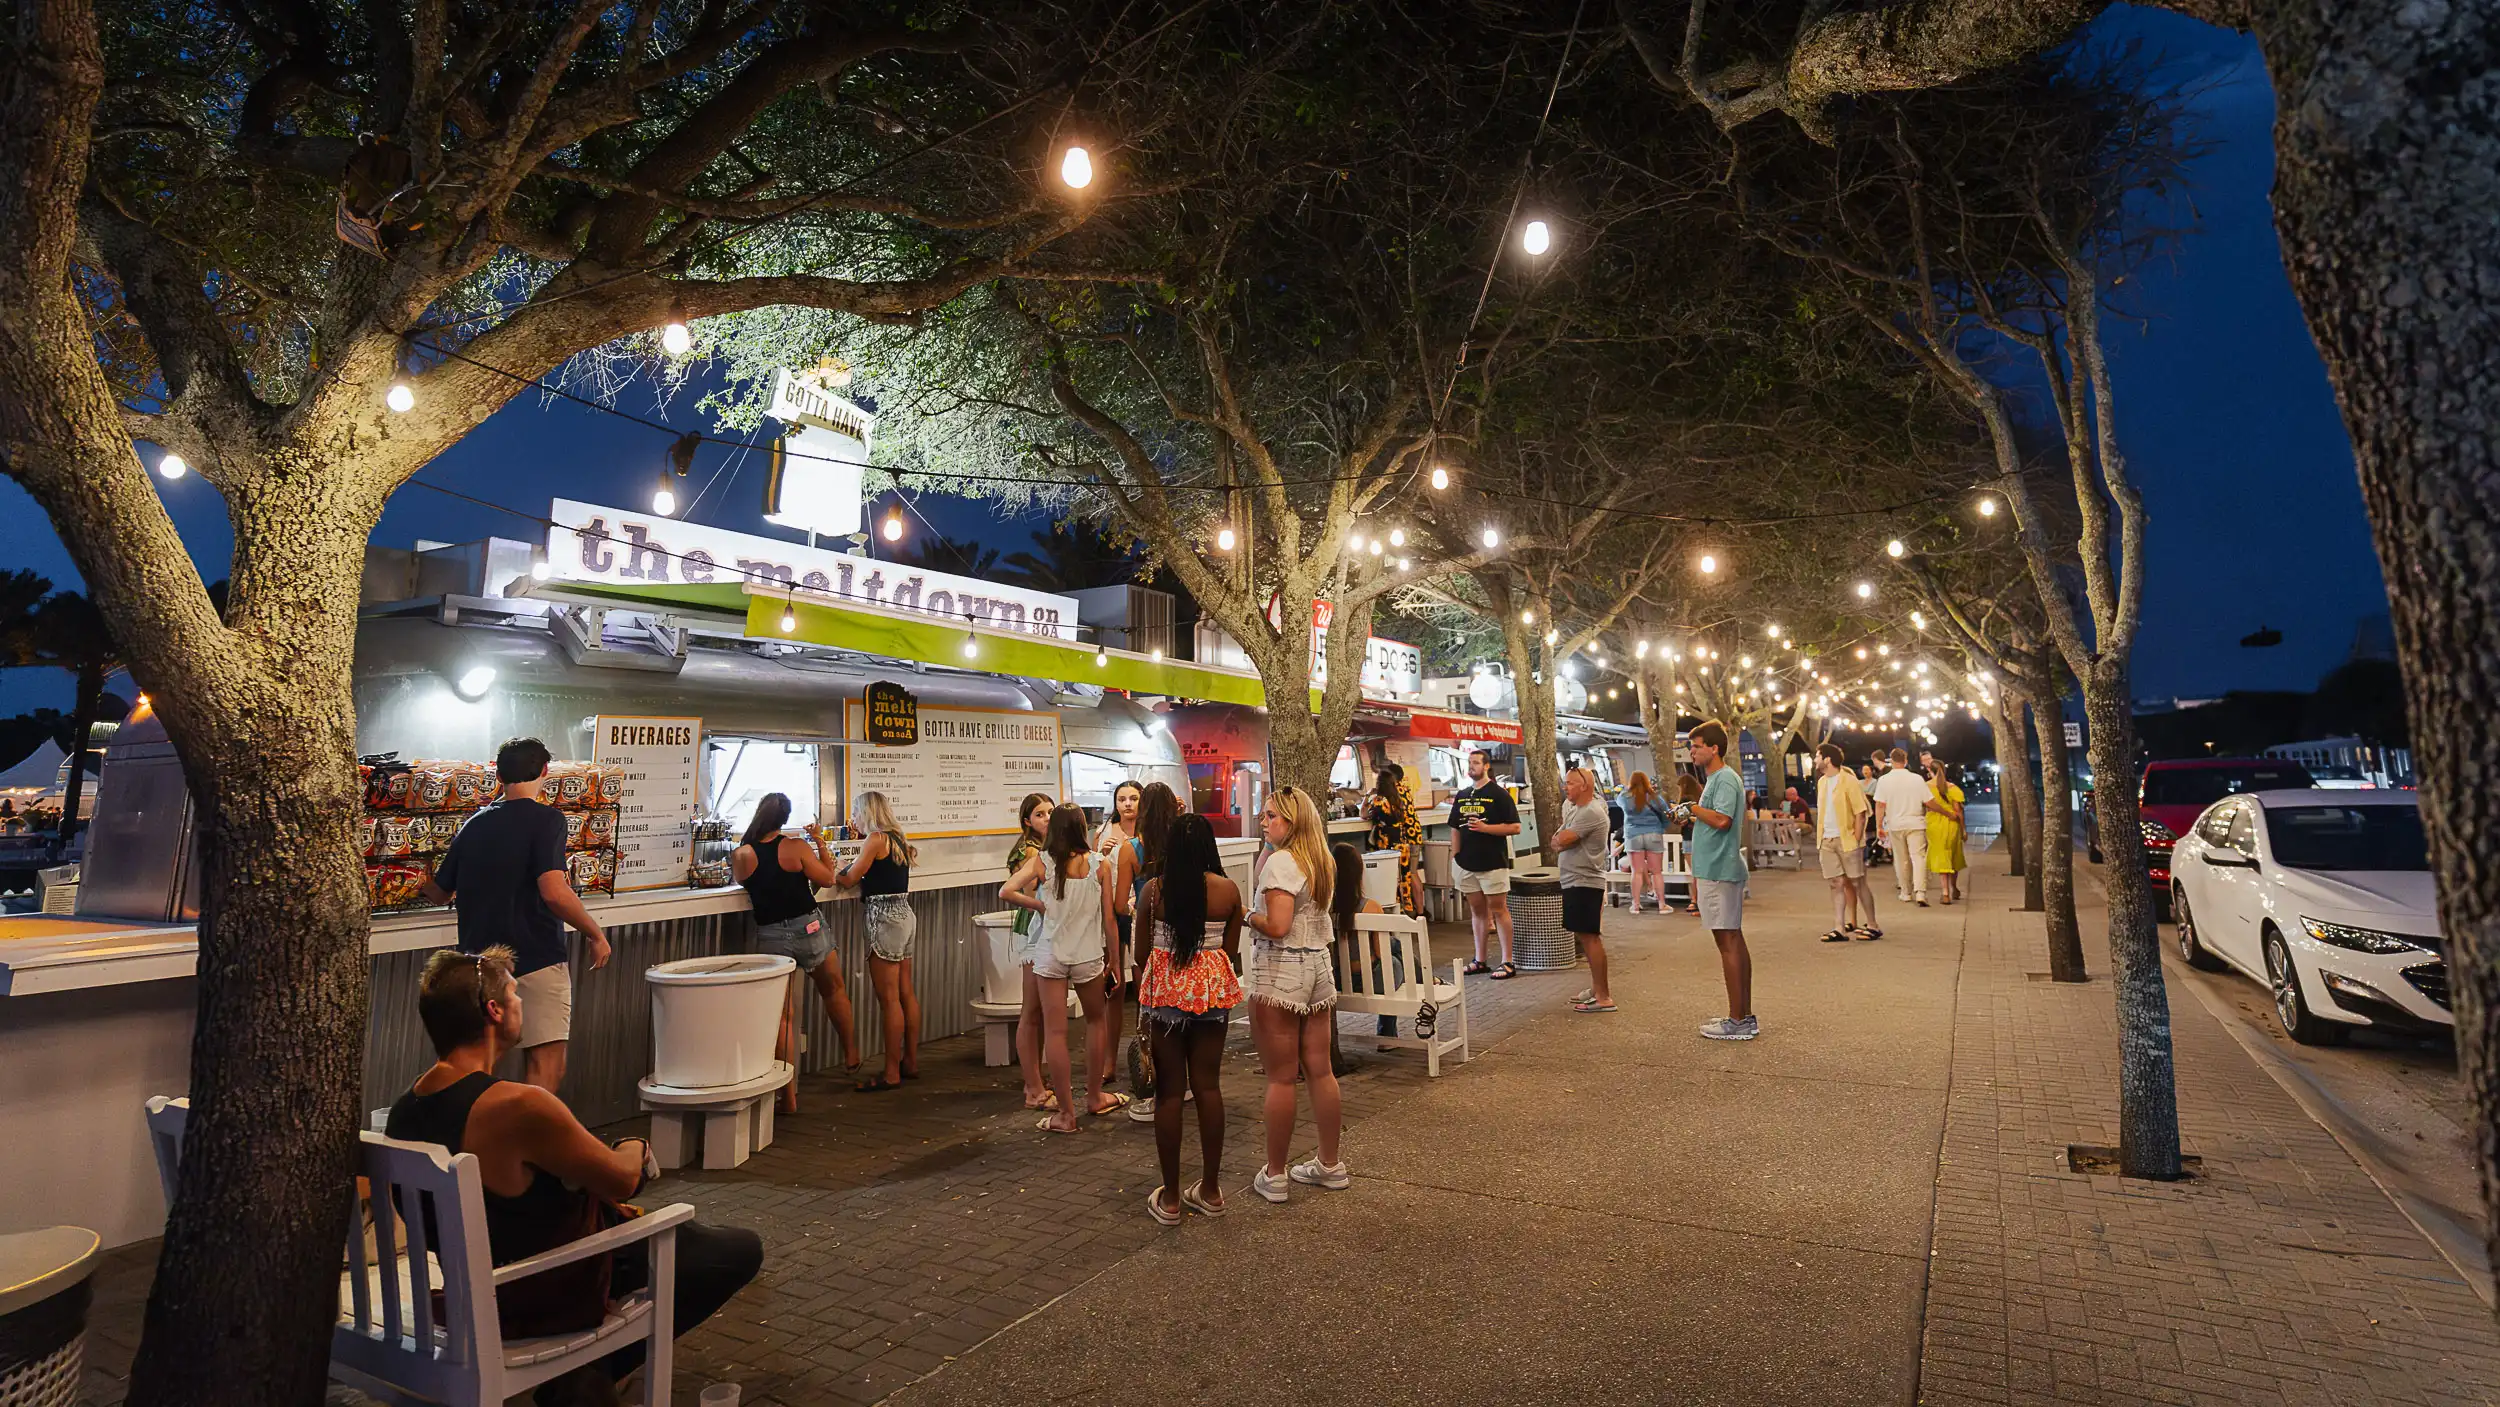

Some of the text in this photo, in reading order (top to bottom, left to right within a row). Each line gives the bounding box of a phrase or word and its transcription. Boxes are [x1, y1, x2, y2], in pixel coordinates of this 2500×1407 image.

[785, 381, 865, 440] GOTTA HAVE
[575, 518, 1027, 632] the meltdown
[1033, 607, 1059, 623] on
[1380, 646, 1416, 674] DOGS
[876, 691, 895, 701] the
[875, 699, 915, 715] melt
[875, 714, 916, 728] down
[611, 725, 691, 746] BEVERAGES
[882, 730, 895, 738] on
[924, 720, 1053, 741] GOTTA HAVE GRILLED CHEESE
[605, 757, 622, 765] PEACE
[624, 757, 633, 765] TEA
[629, 773, 646, 781] WATER
[630, 805, 644, 813] BEER
[625, 860, 646, 868] DRINKS
